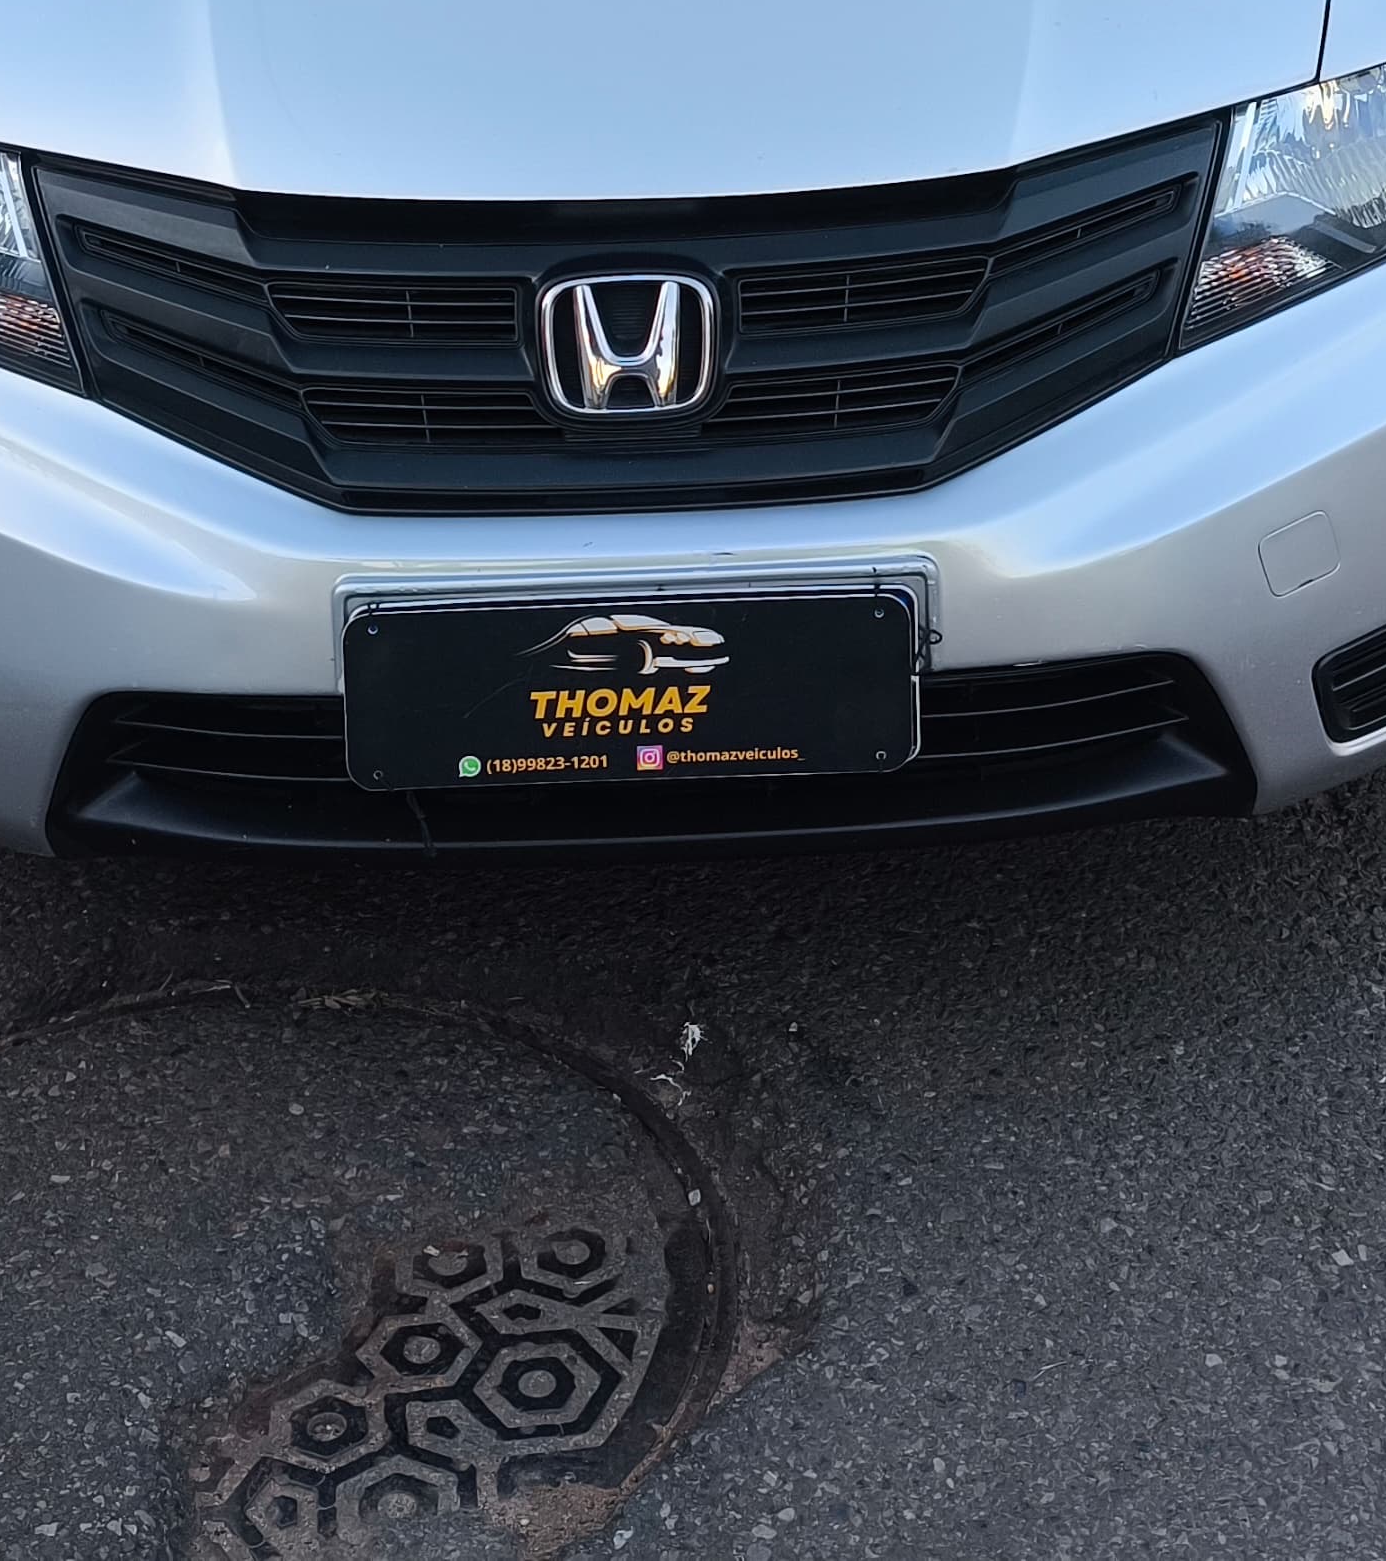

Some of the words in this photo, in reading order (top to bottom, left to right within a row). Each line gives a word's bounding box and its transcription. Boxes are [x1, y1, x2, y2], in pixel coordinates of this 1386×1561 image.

[530, 685, 711, 719] THOMAZ
[542, 717, 695, 738] VEÍCULOS
[486, 754, 608, 774] (18)99823-1201
[666, 746, 806, 764] @thomazveiculos_
